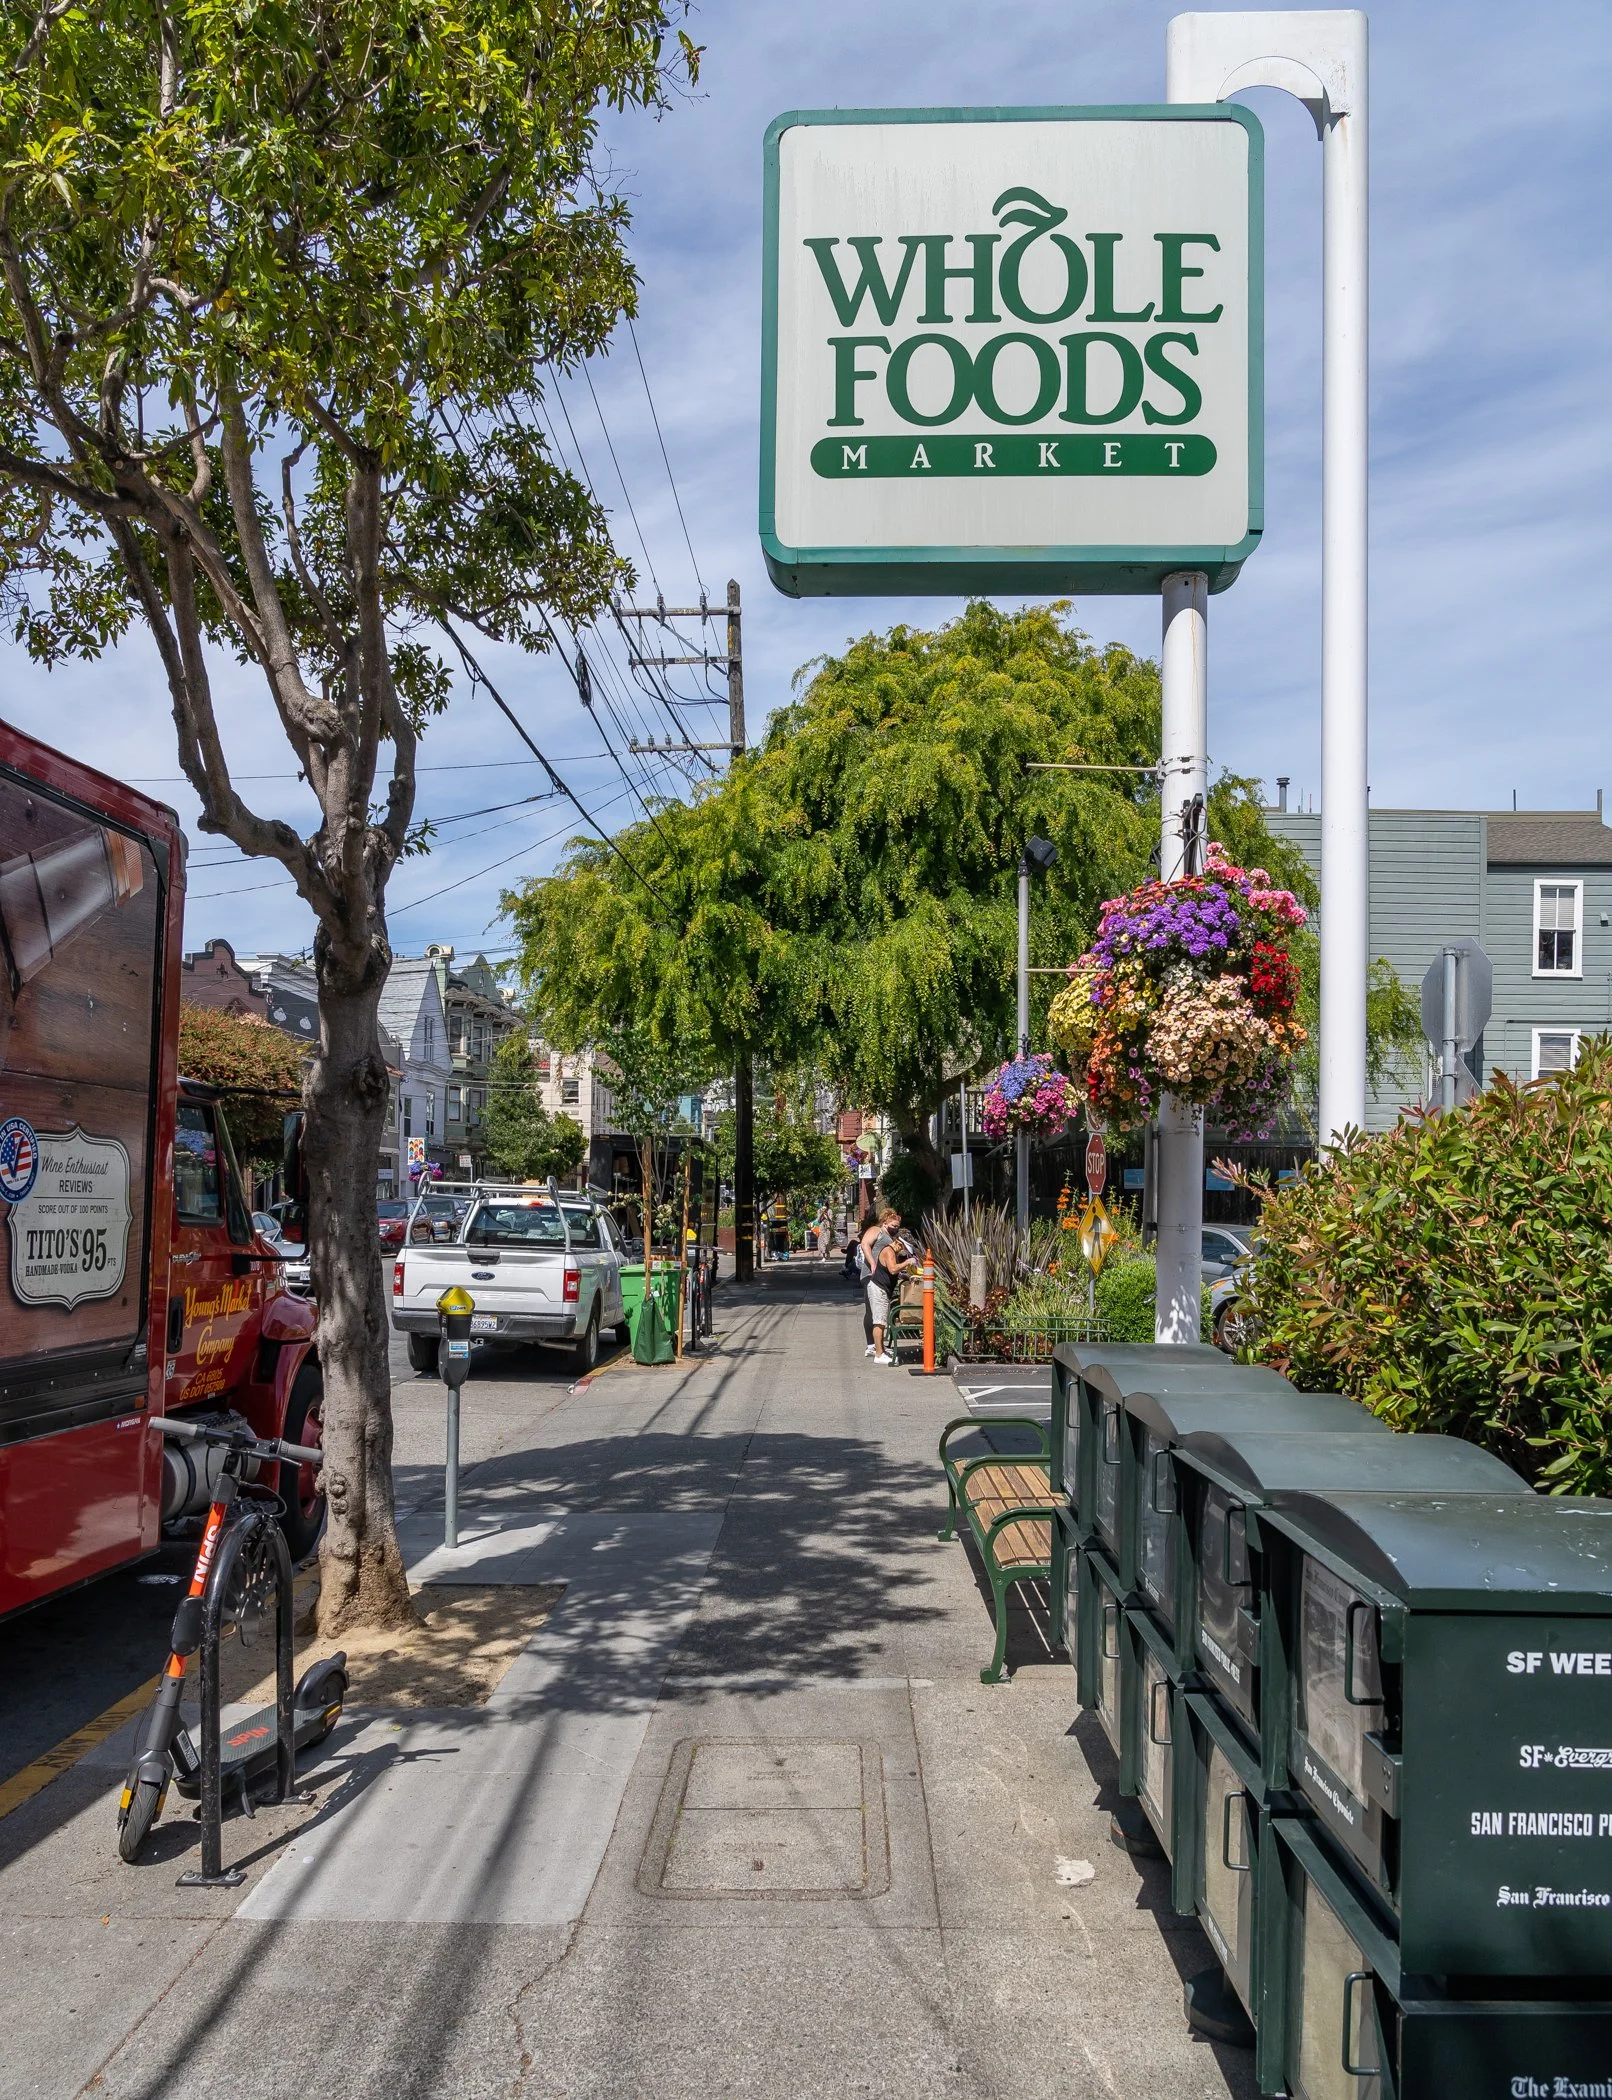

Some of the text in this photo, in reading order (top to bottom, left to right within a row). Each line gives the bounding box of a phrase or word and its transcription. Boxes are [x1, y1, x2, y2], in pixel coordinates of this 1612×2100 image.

[803, 230, 1224, 327] WHOLE
[826, 332, 1203, 427] FOODS
[841, 442, 1186, 471] MARKET
[6, 1122, 18, 1131] USA
[41, 1156, 109, 1176] Wine Enthusiast
[1088, 1152, 1105, 1174] STOP
[59, 1179, 93, 1193] REVIEWS
[38, 1204, 109, 1215] SCORE OUT OF 100 POINTS
[26, 1228, 107, 1272] TITO'S 95
[25, 1263, 78, 1277] HANDMADE VODKA
[107, 1257, 117, 1267] PTS
[184, 1283, 252, 1329] Young's Market
[196, 1325, 235, 1366] Company
[193, 1525, 219, 1584] SPIN
[1506, 1651, 1612, 1675] SF WEE
[226, 1727, 270, 1747] SPIN
[1519, 1745, 1545, 1768] SF
[1471, 1812, 1502, 1836] SAN
[1508, 1812, 1593, 1837] FRANCISCO
[1497, 1886, 1610, 1909] San Francisco
[1511, 2076, 1549, 2098] The
